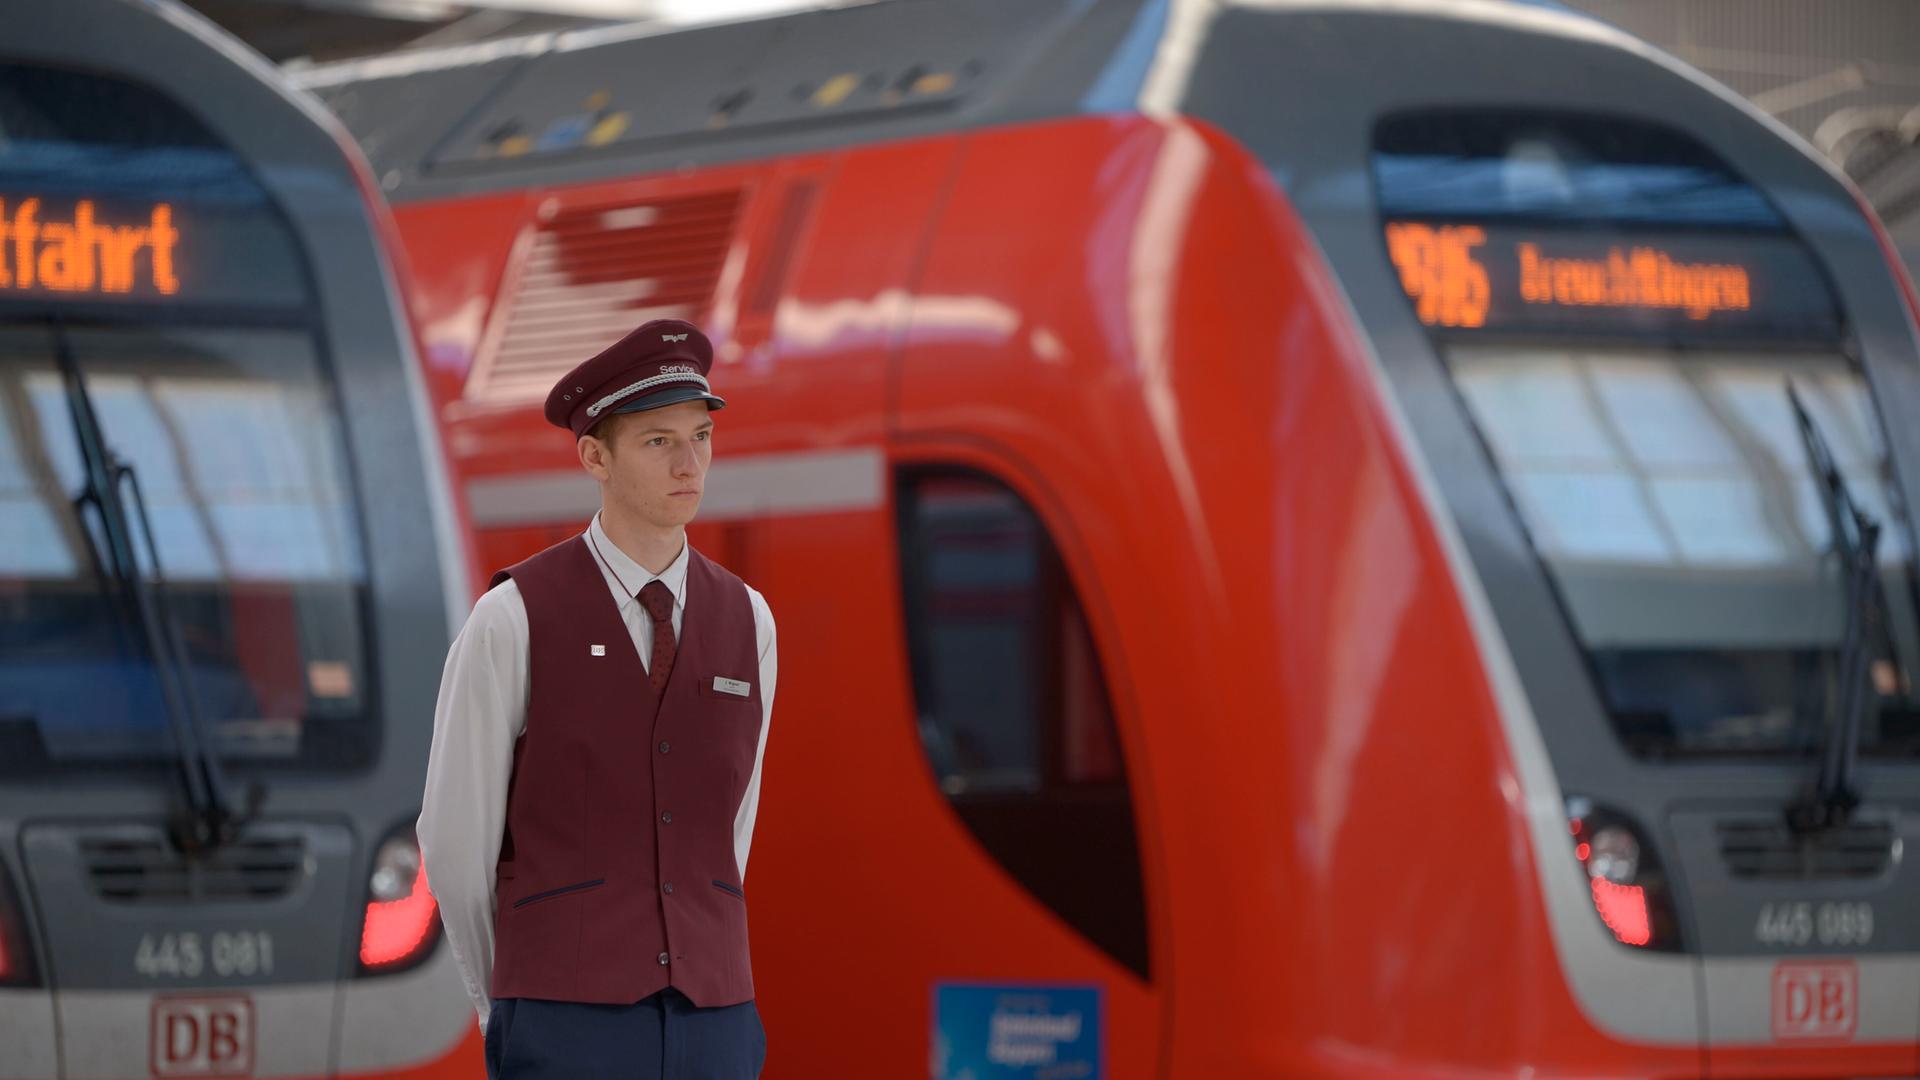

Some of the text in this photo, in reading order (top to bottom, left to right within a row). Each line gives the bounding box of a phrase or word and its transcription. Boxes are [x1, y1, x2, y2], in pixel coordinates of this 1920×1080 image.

[659, 364, 695, 375] Service
[1755, 901, 1812, 945] 445
[135, 930, 273, 977] 445 081
[1785, 979, 1845, 1023] DB
[165, 1011, 240, 1064] DB
